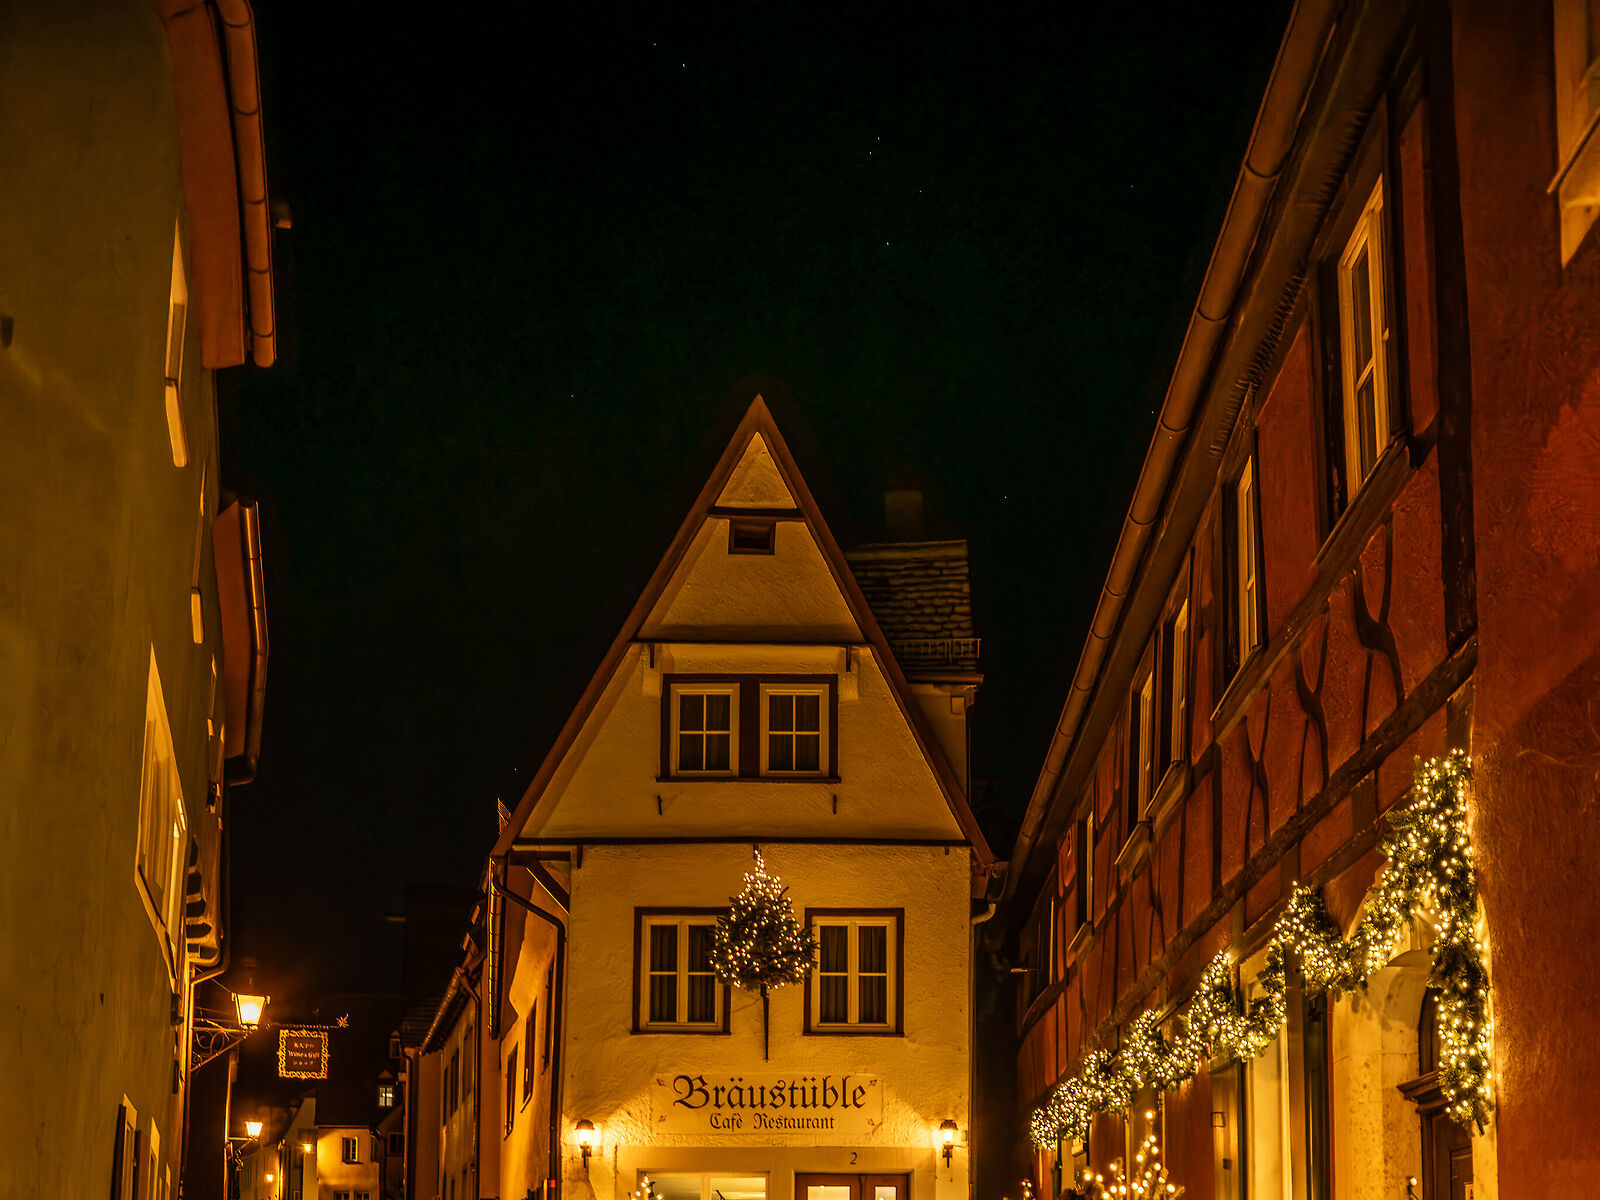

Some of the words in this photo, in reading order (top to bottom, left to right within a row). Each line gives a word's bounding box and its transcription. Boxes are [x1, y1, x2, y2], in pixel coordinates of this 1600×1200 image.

[673, 1075, 867, 1109] Bräustüble
[753, 1113, 835, 1129] Restaurant
[849, 1152, 858, 1165] 2
